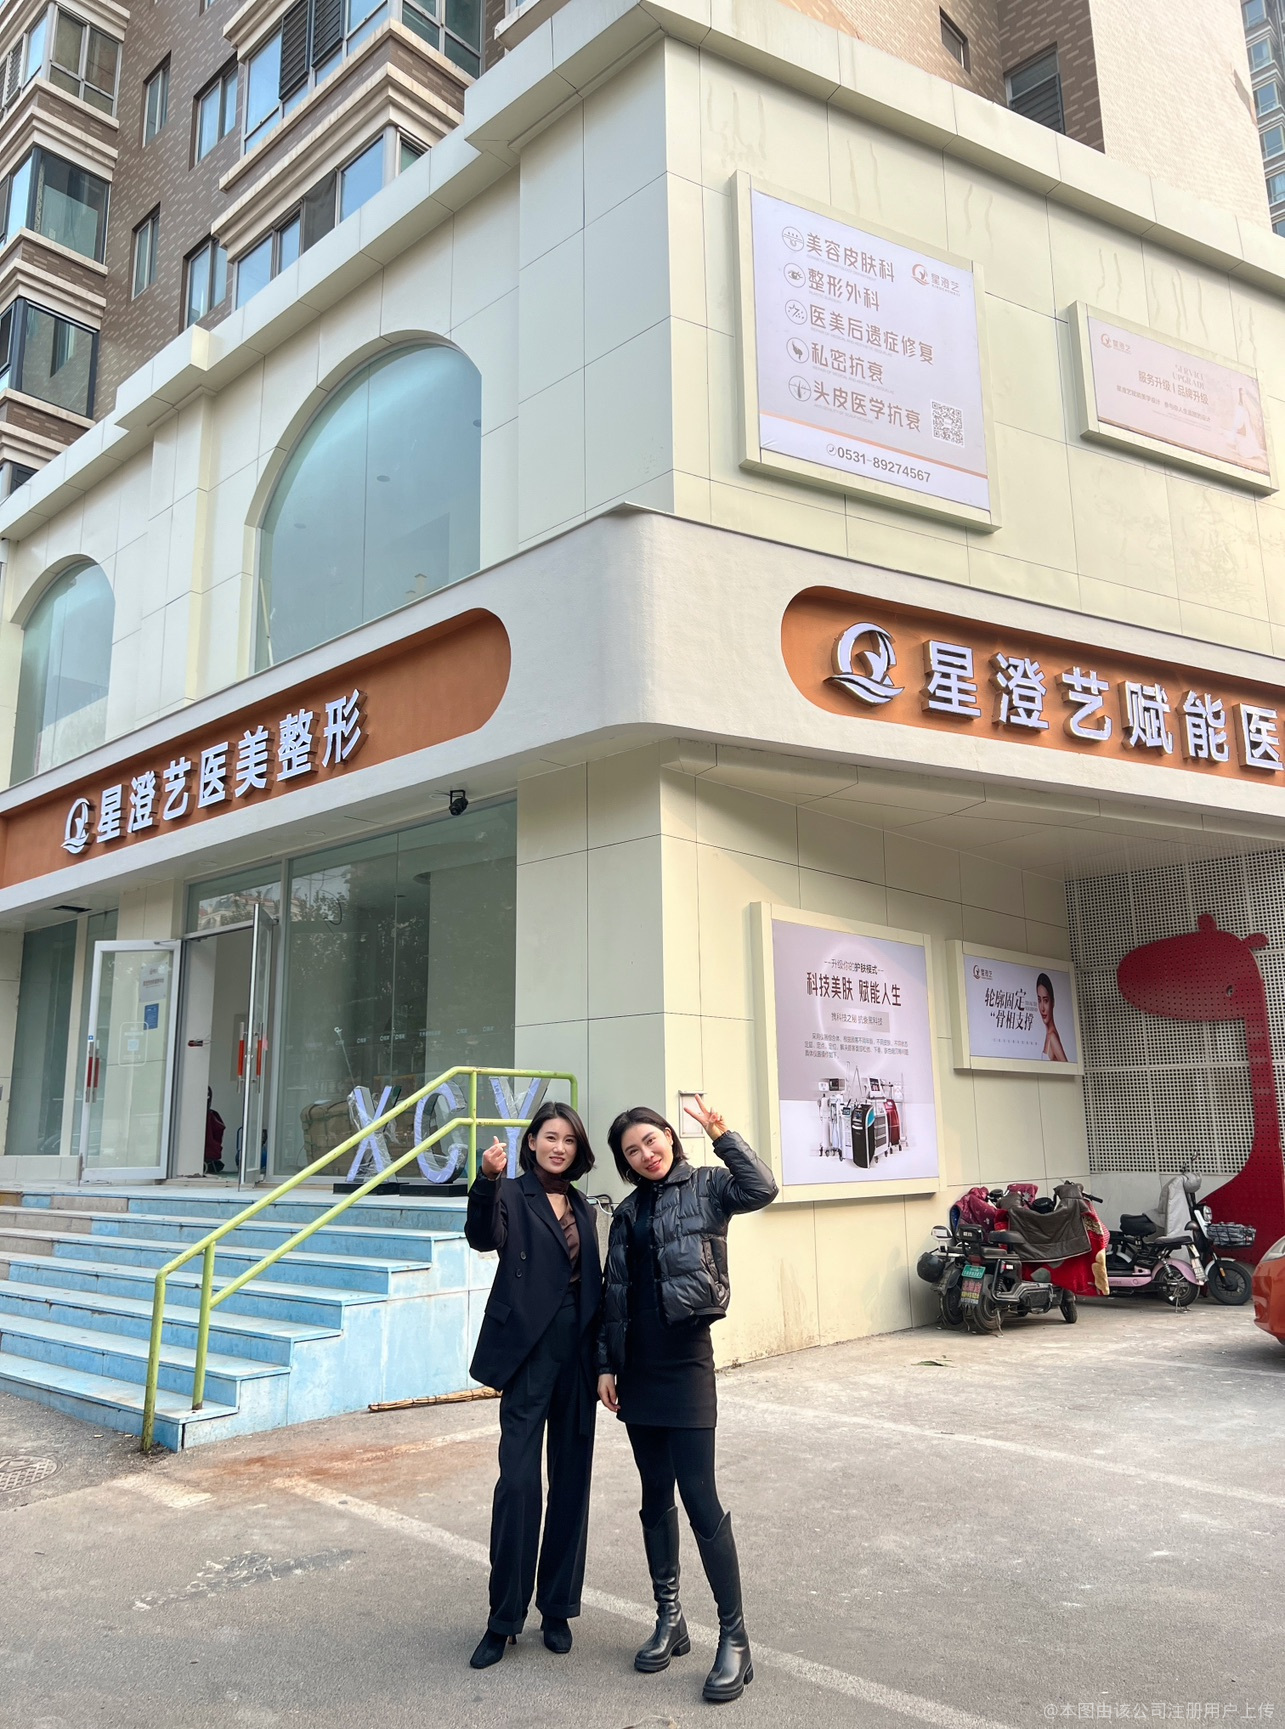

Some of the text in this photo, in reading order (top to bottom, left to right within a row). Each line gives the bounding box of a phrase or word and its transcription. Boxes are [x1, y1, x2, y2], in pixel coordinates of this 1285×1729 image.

[806, 232, 895, 283] 美容皮肤科
[808, 267, 880, 312] 整形外科
[810, 304, 934, 365] 医美后遗症修复
[811, 342, 883, 385] 私密抗衰
[814, 380, 921, 433] 头皮医学抗衰
[1138, 370, 1171, 393] 服务升级
[1177, 384, 1209, 406] 品牌升级
[837, 446, 931, 483] 0531-89274567
[923, 639, 1283, 772] 星澄艺赋能医
[97, 688, 367, 845] 星澄艺医美整形
[807, 972, 901, 1006] 科技美肤 赋能人生
[985, 988, 1027, 1011] 轮廓固定
